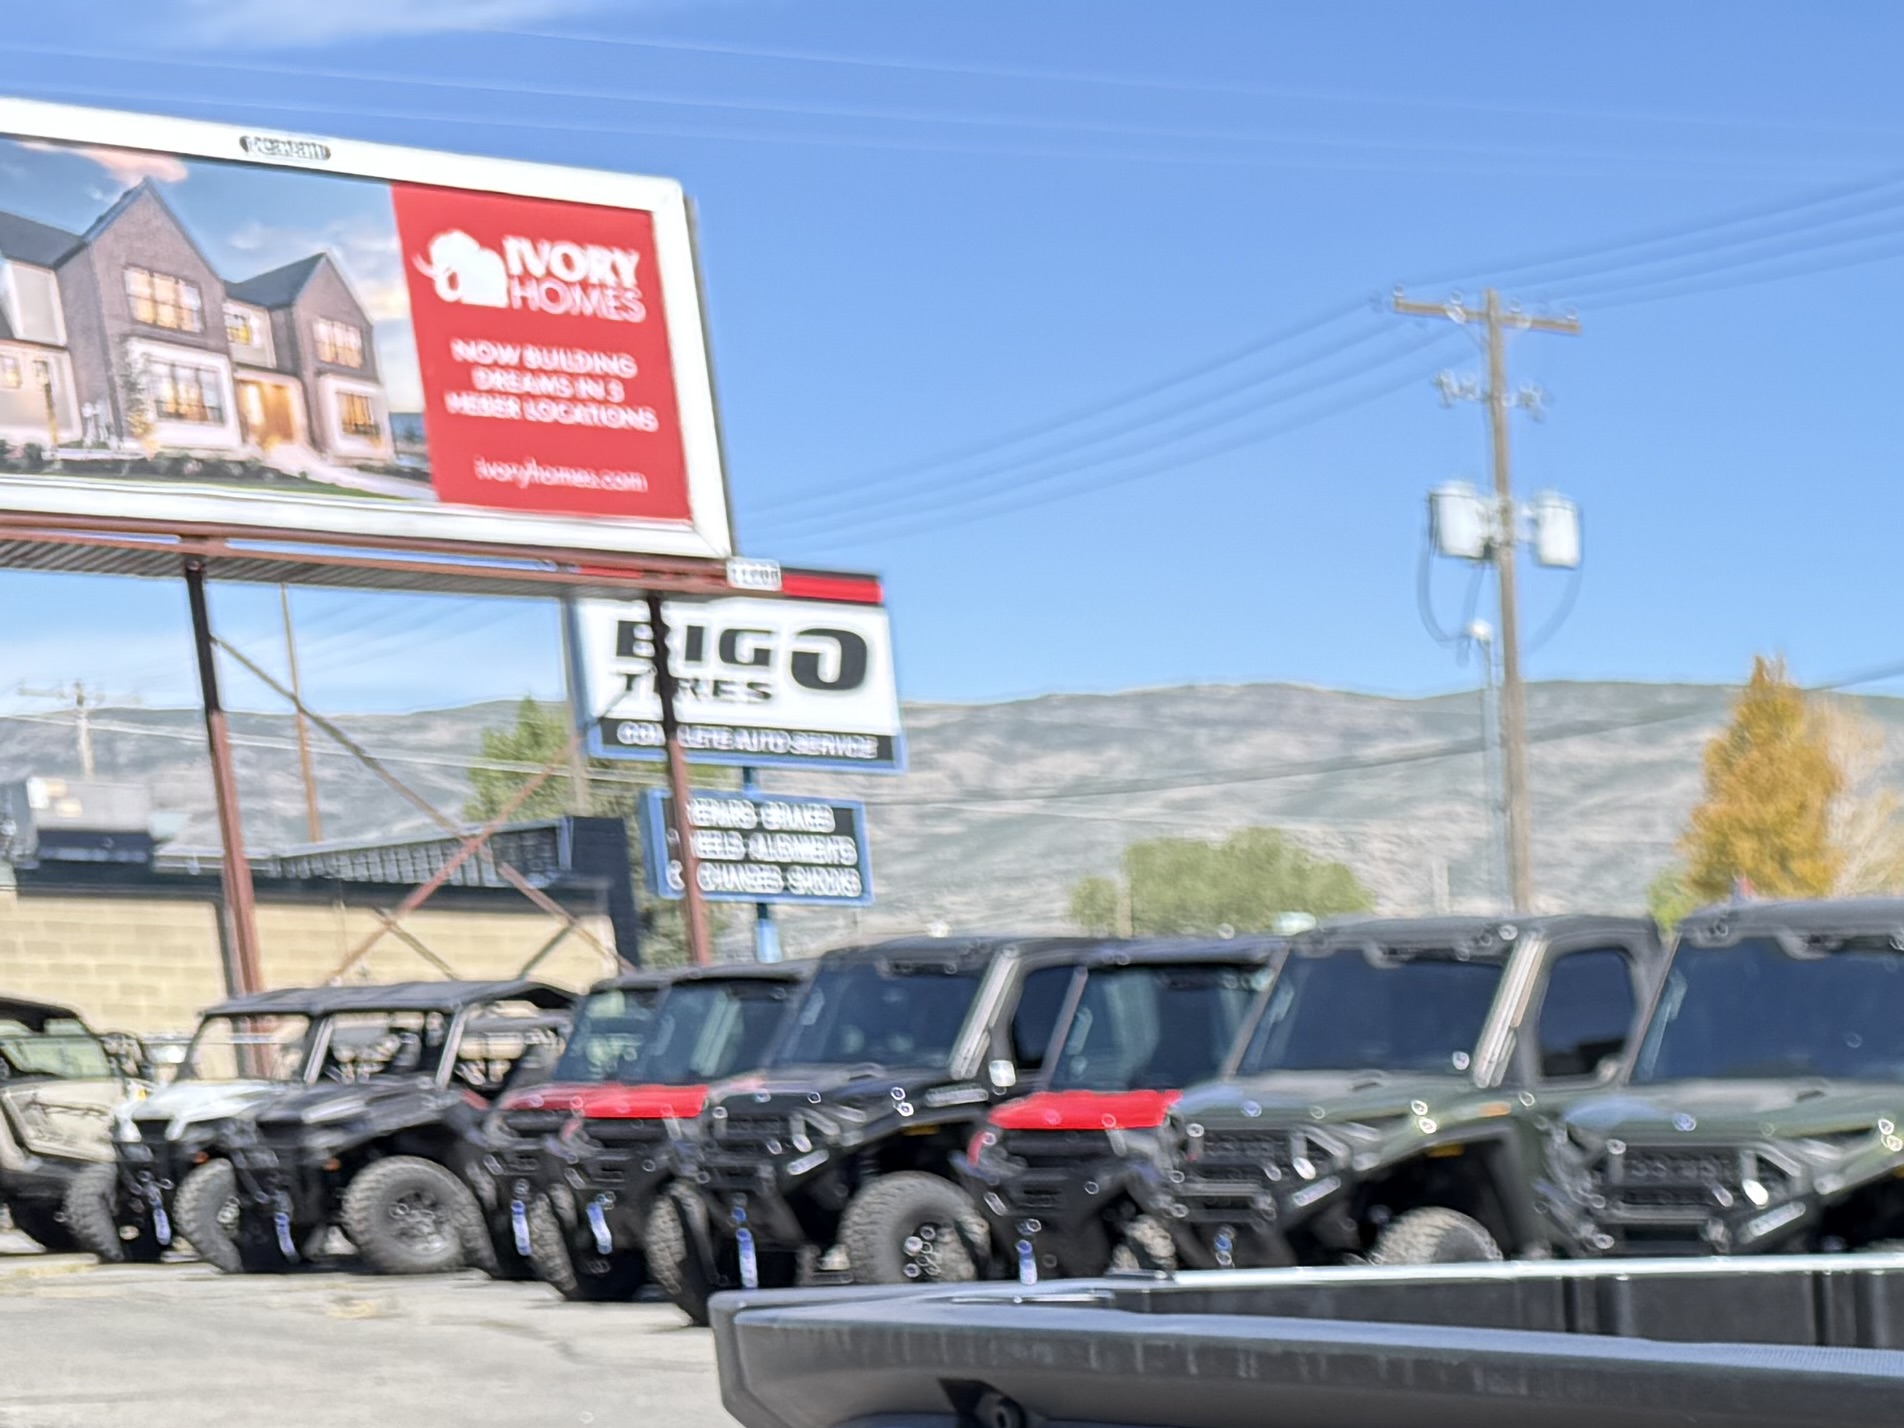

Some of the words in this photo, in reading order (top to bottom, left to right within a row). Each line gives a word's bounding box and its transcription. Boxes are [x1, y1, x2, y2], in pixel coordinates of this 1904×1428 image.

[502, 235, 640, 288] IVORY
[510, 275, 646, 323] HOMES
[451, 338, 521, 365] NOW
[523, 343, 638, 378] BUILDING
[472, 366, 573, 398] DREAMS
[523, 397, 658, 432] LOCATIONS
[616, 620, 774, 666] BIG
[791, 627, 868, 691] O
